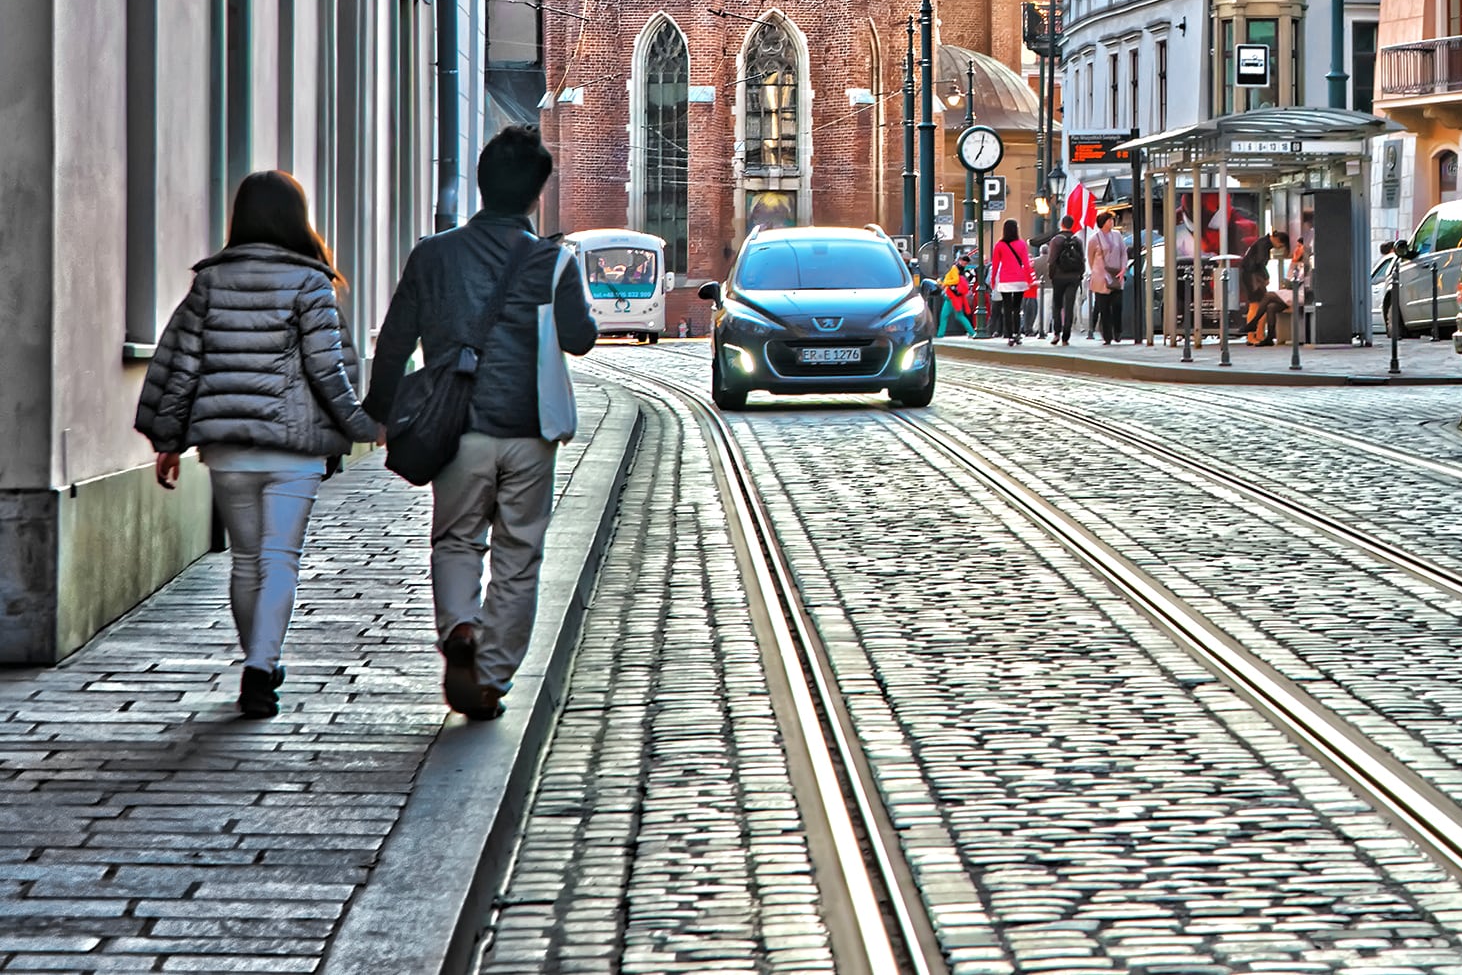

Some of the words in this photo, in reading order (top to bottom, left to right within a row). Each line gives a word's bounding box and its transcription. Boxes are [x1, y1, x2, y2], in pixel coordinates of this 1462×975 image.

[984, 179, 1000, 201] P
[934, 195, 949, 216] P
[966, 222, 974, 234] P
